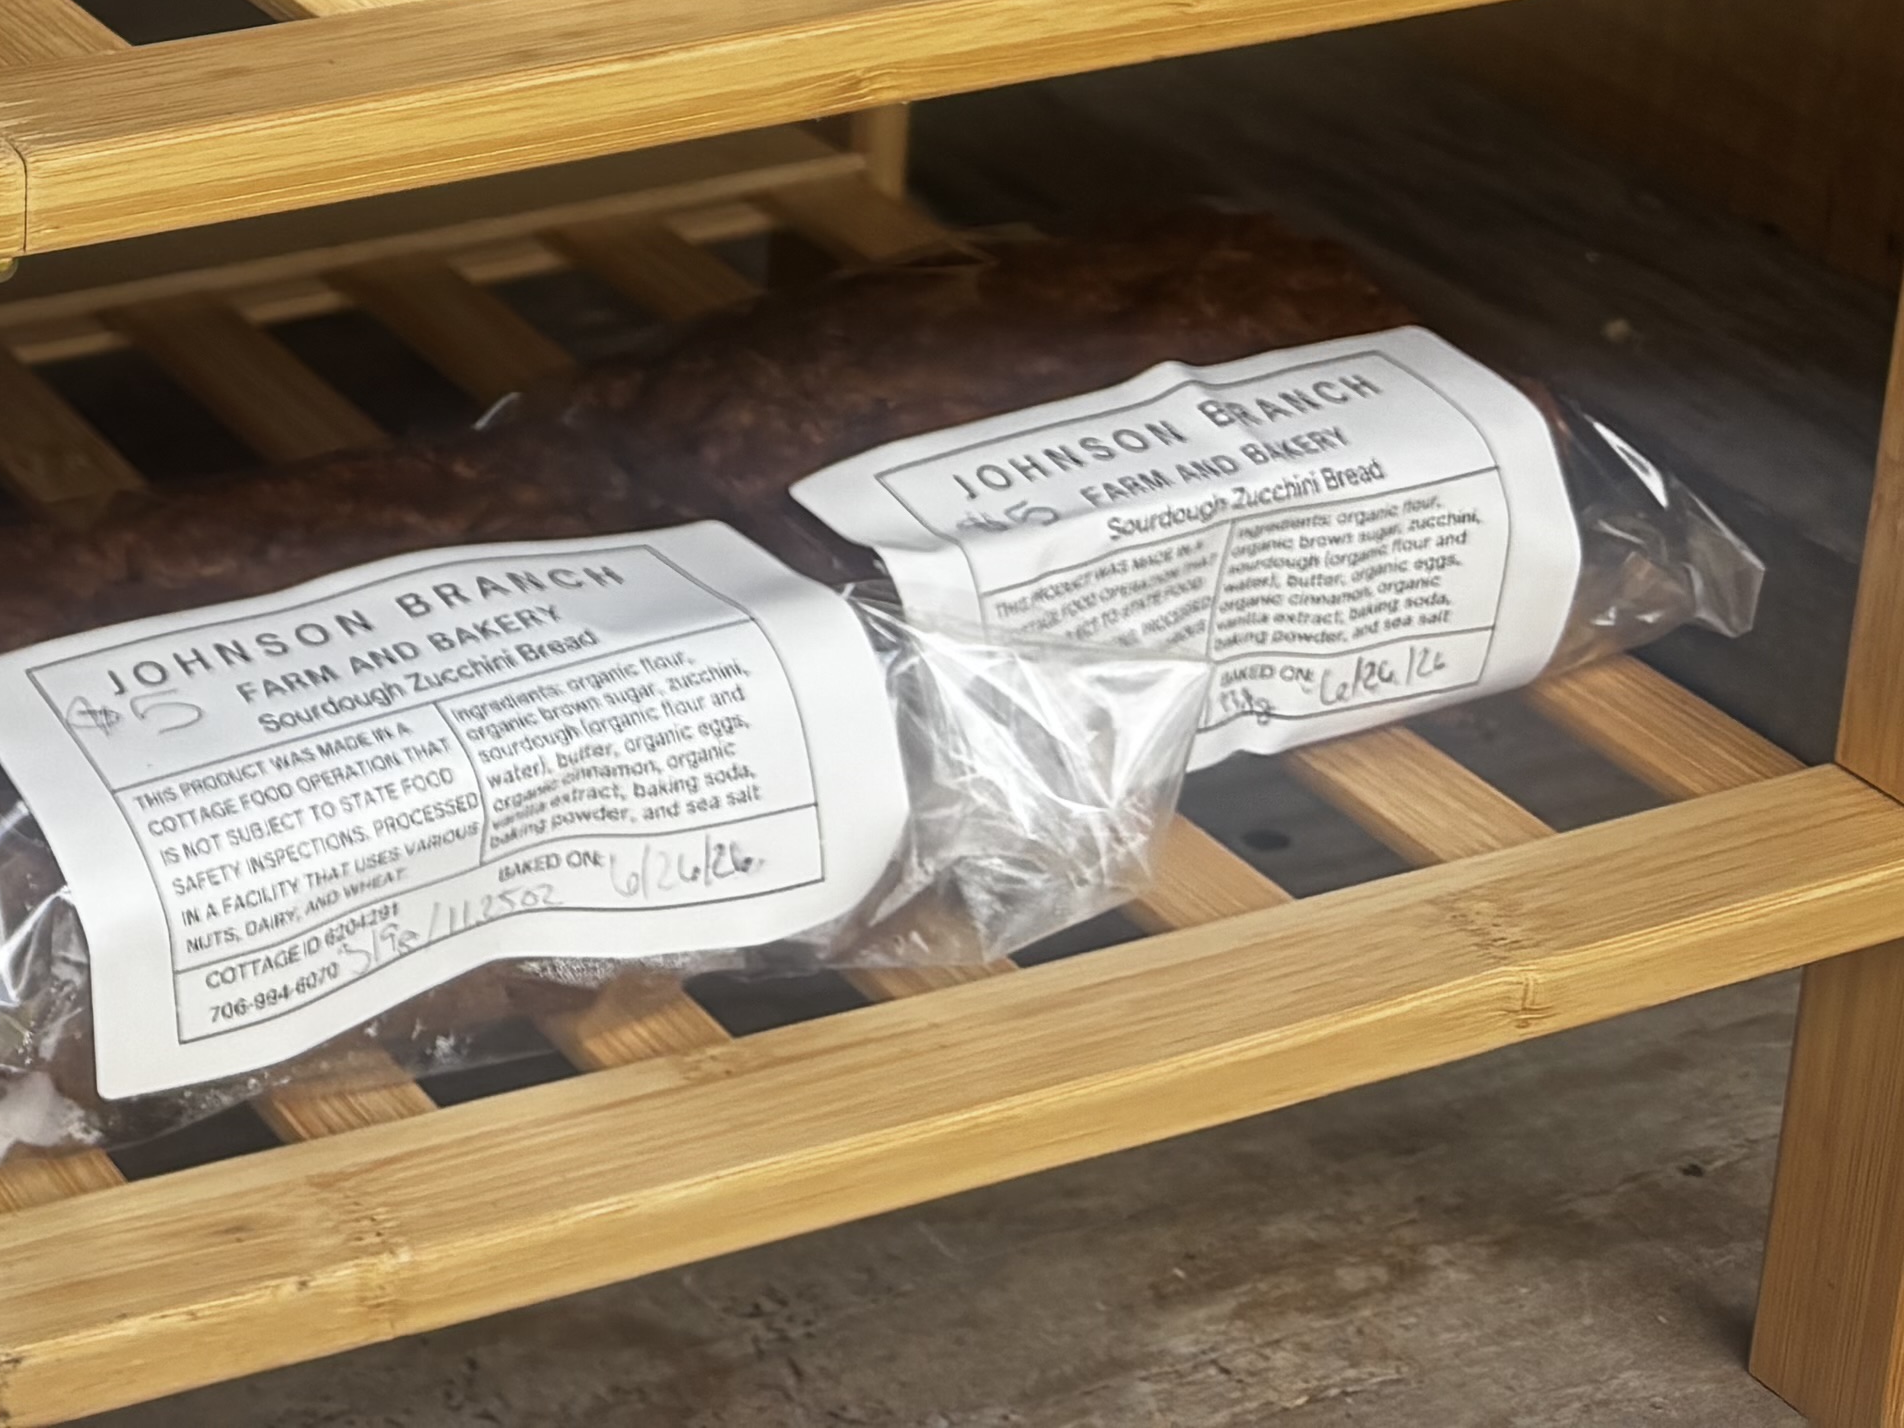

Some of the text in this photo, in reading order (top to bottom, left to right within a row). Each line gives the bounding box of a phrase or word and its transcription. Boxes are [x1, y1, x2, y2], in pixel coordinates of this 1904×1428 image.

[952, 374, 1382, 500] JOHNSON BRANCH
[1080, 427, 1349, 507] FARM AND BAKERY
[1107, 457, 1387, 540] Sourdough Zucchini Bread
[106, 565, 626, 698] JOHNSON BRANCH
[235, 604, 563, 704] FARM AND BAKERY
[258, 628, 600, 733] Sourdough Zucchini Bread
[205, 947, 302, 990] COTTAGE
[302, 934, 321, 955] ID
